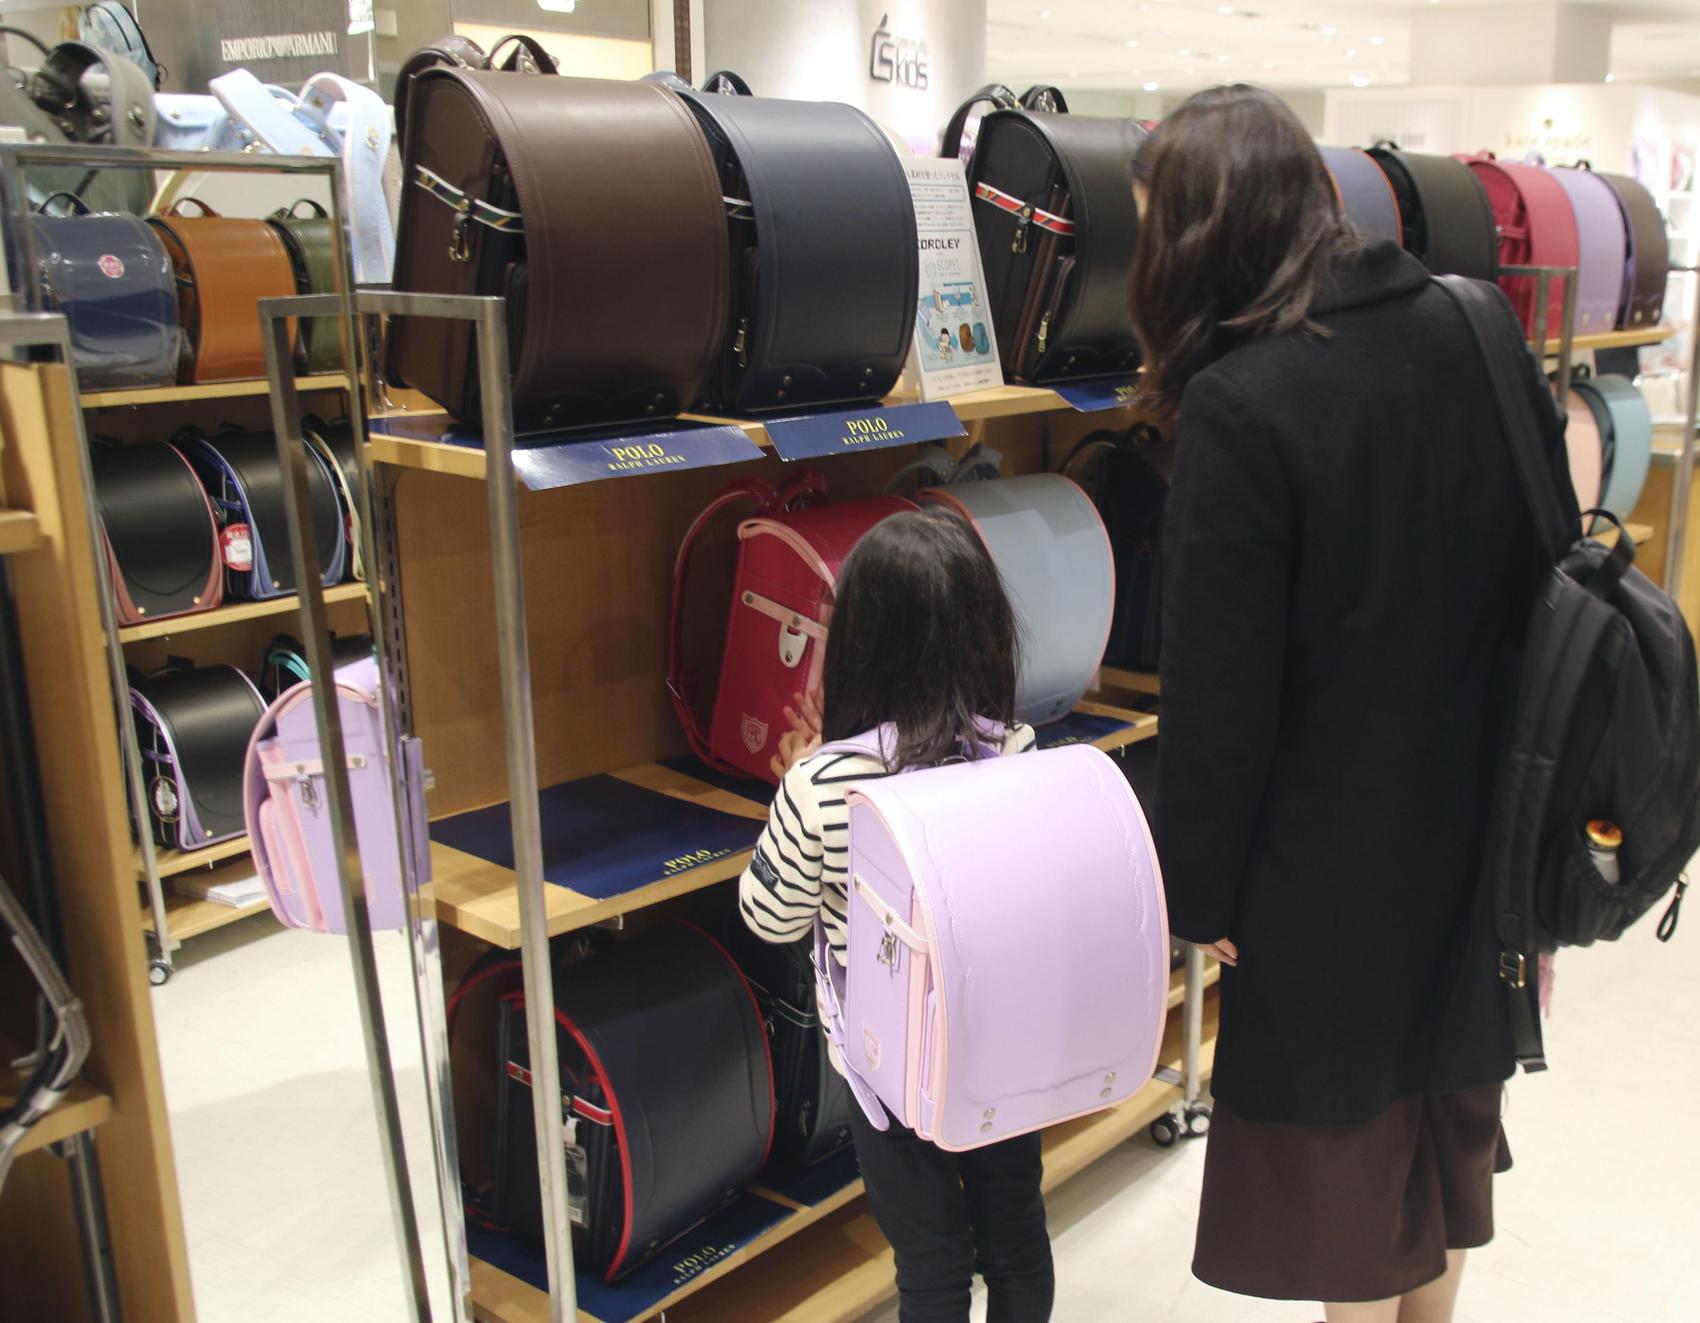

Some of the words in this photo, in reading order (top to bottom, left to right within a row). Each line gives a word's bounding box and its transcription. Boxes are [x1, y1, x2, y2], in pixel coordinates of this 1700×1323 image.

[221, 37, 273, 61] EMPORIO
[287, 31, 338, 56] ARMANI
[918, 238, 960, 250] ORDLEY
[847, 417, 888, 435] POLO
[843, 434, 871, 446] RALPH
[872, 429, 905, 441] LAUREN
[611, 443, 665, 461] POLO
[607, 459, 644, 471] RALPH
[645, 454, 686, 466] LAUREN
[664, 849, 711, 869] POLO
[673, 1246, 716, 1273] POLO
